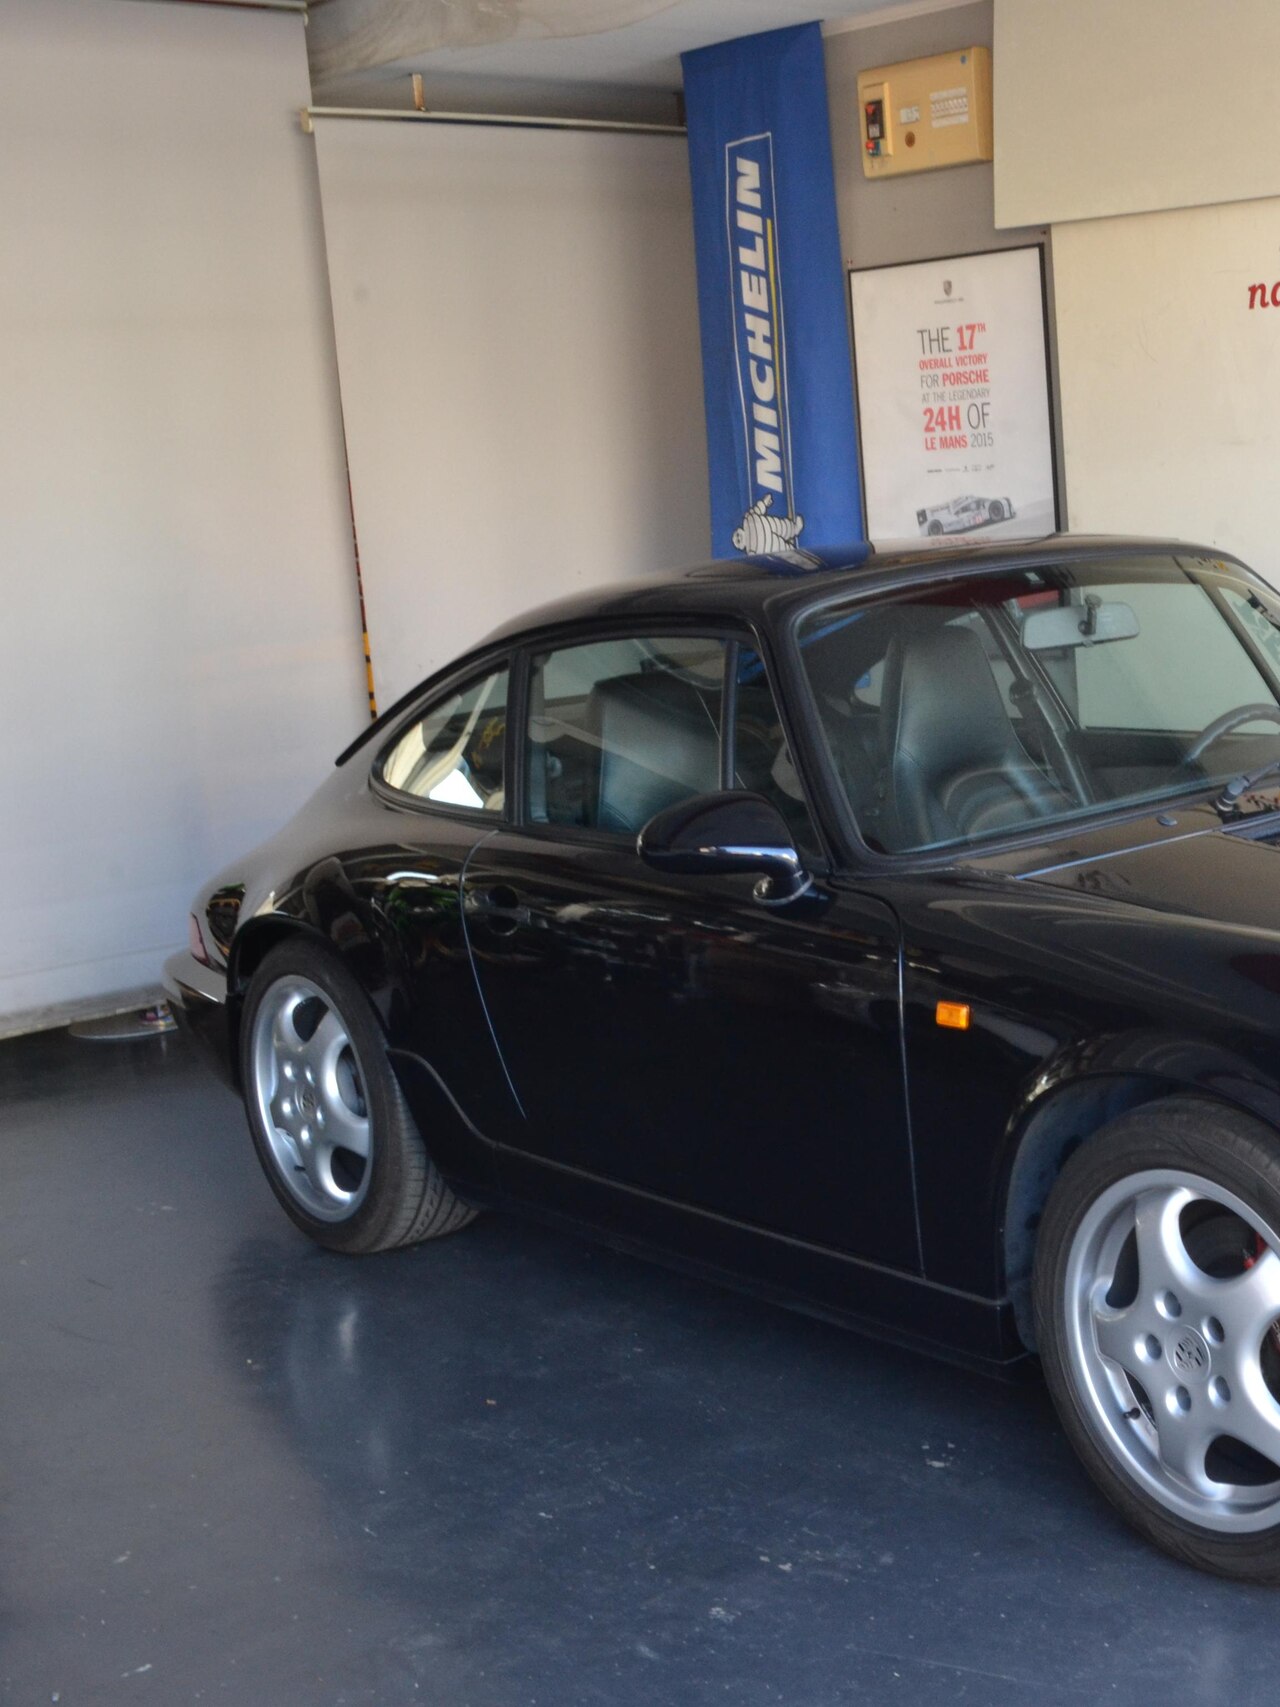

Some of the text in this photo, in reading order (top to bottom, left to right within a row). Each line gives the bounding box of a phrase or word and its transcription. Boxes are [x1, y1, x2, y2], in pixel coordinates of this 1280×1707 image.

[736, 157, 783, 493] MICHELIN
[917, 327, 952, 355] THE
[919, 353, 988, 370] OVERALL VICTORY
[921, 369, 989, 389] FOR PORSCHE
[921, 388, 991, 403] AT THE LEGENDARY
[923, 403, 991, 432] 24H OF
[925, 432, 994, 451] LE MANS 2015
